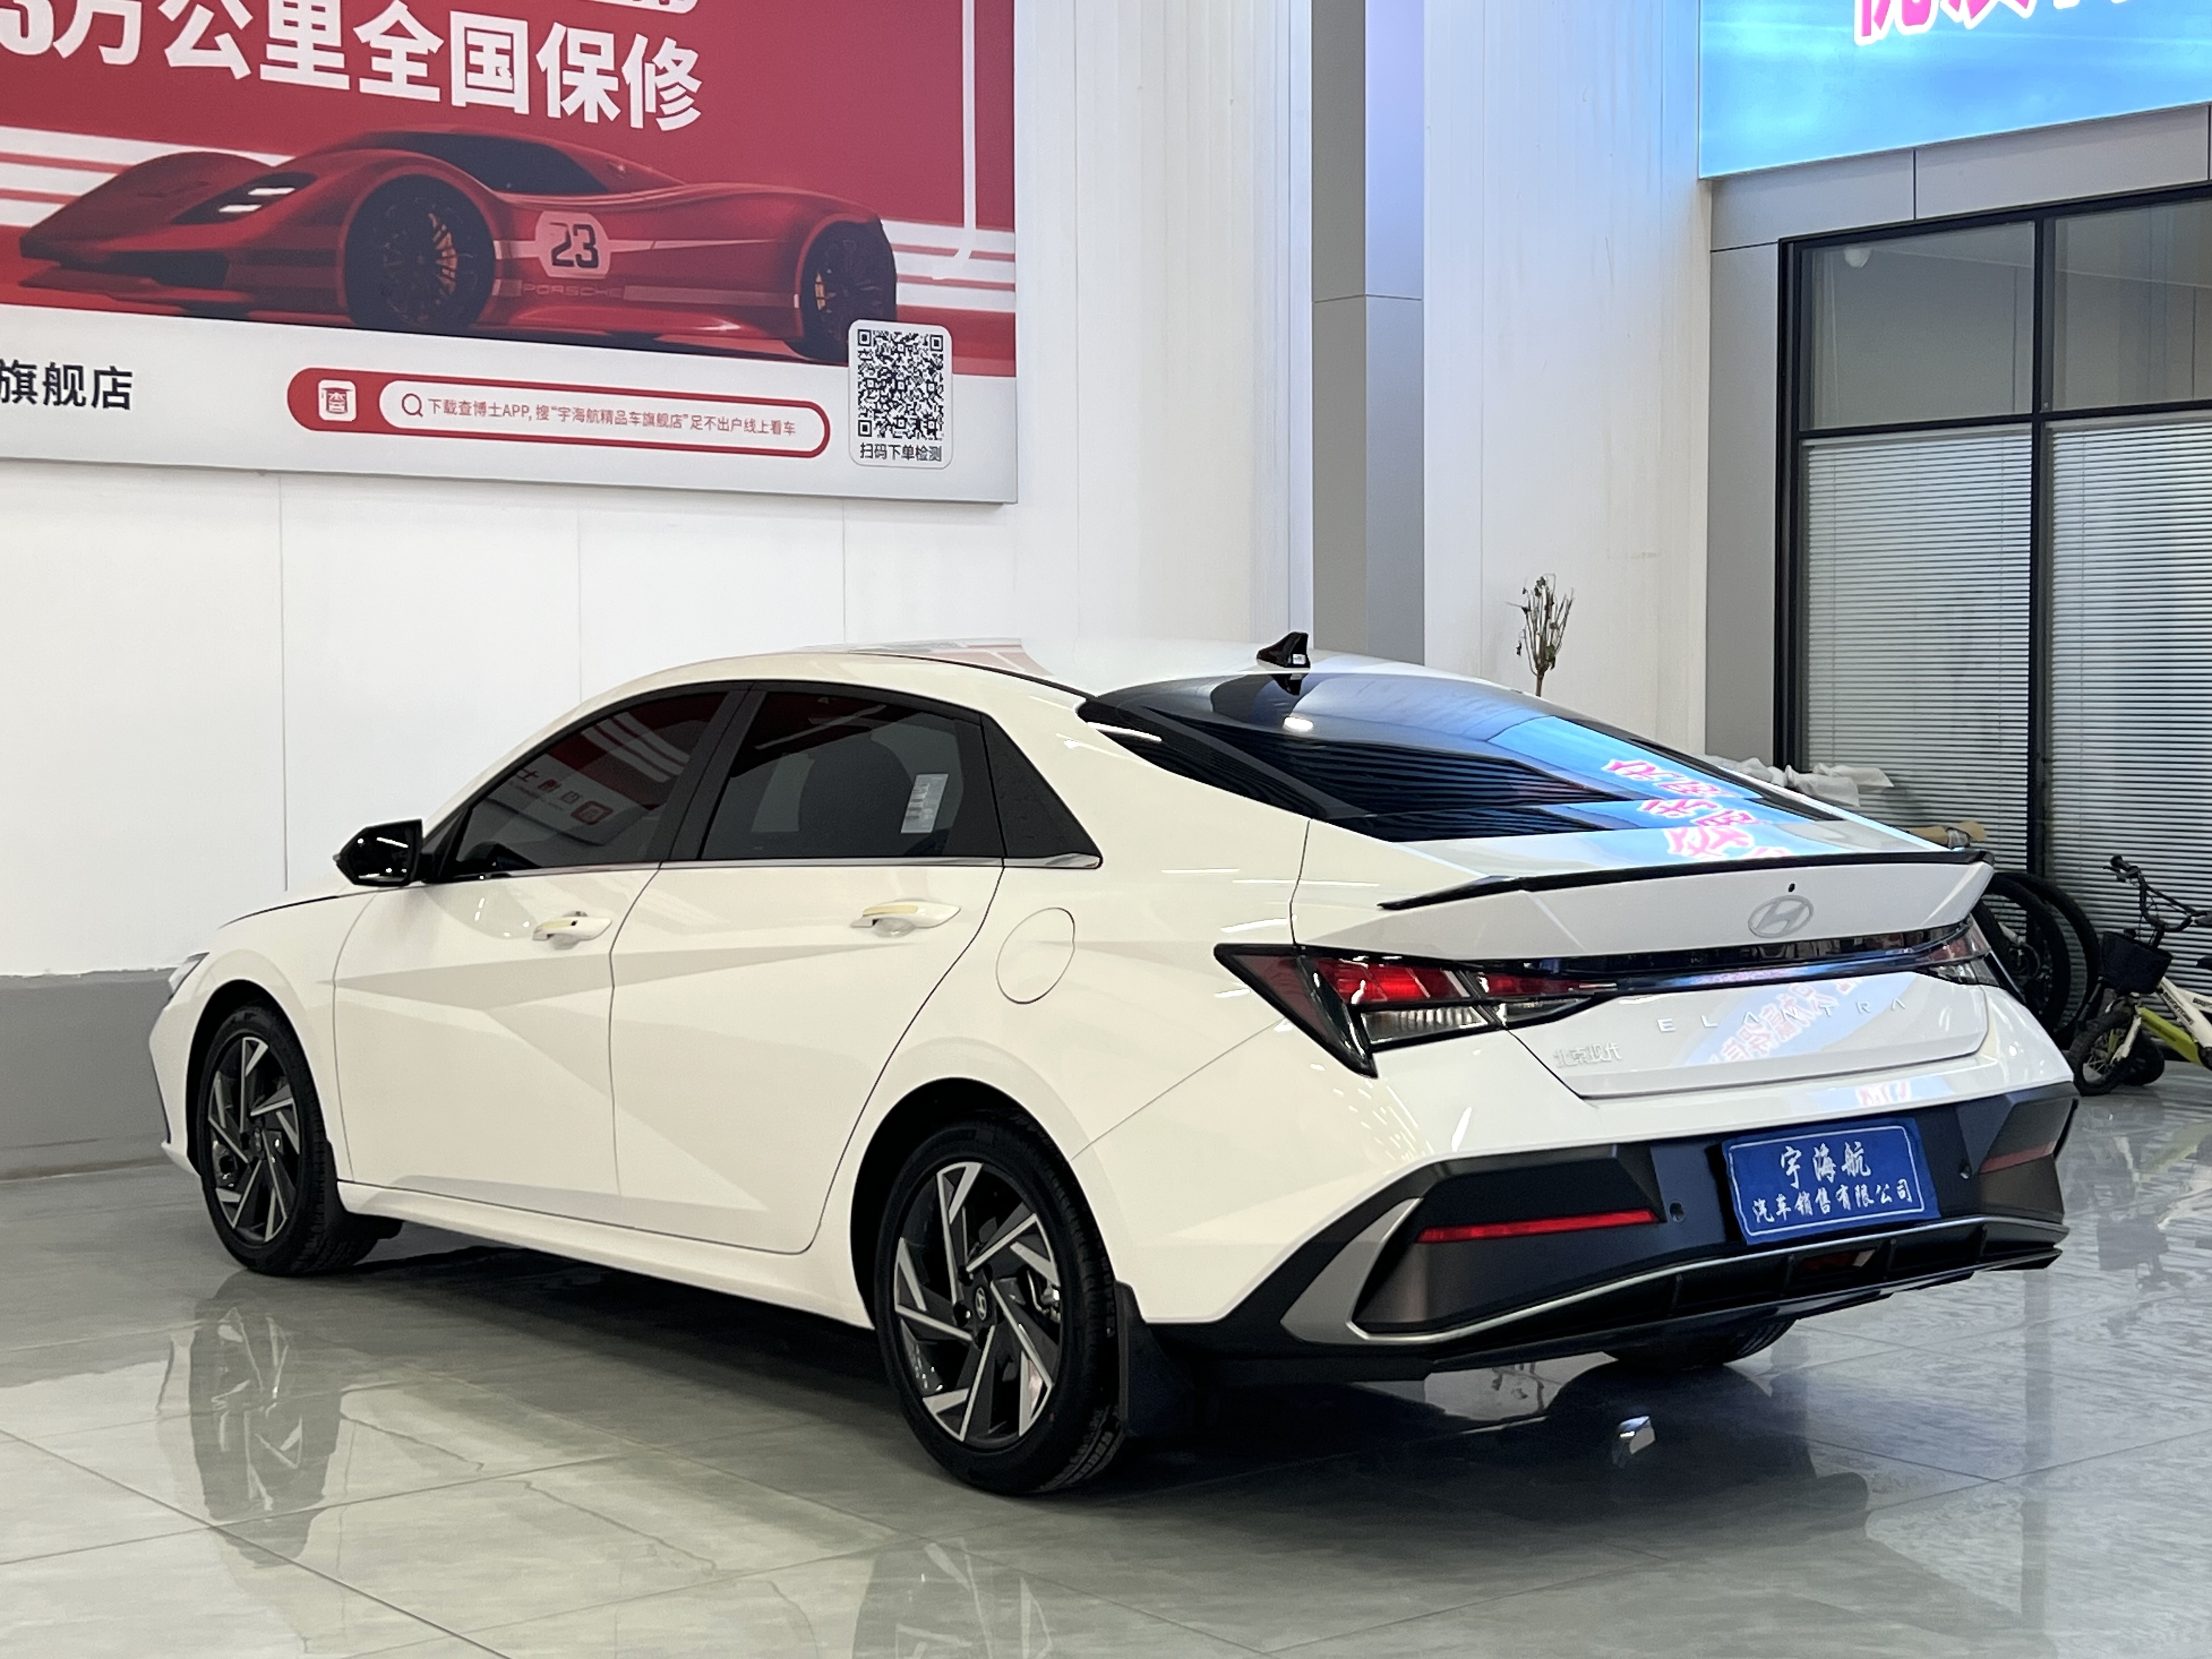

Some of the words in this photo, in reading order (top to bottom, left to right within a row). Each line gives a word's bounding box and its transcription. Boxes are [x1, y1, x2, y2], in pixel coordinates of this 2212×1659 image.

[549, 222, 599, 268] 23
[0, 359, 133, 410] 旗舰店
[860, 442, 943, 462] 扫码下单检测
[1657, 997, 1906, 1032] ELANTRA
[1553, 1042, 1623, 1068] 北京现代
[1780, 1141, 1871, 1189] 宇海航
[1752, 1178, 1913, 1224] 汽车销售有限公司
